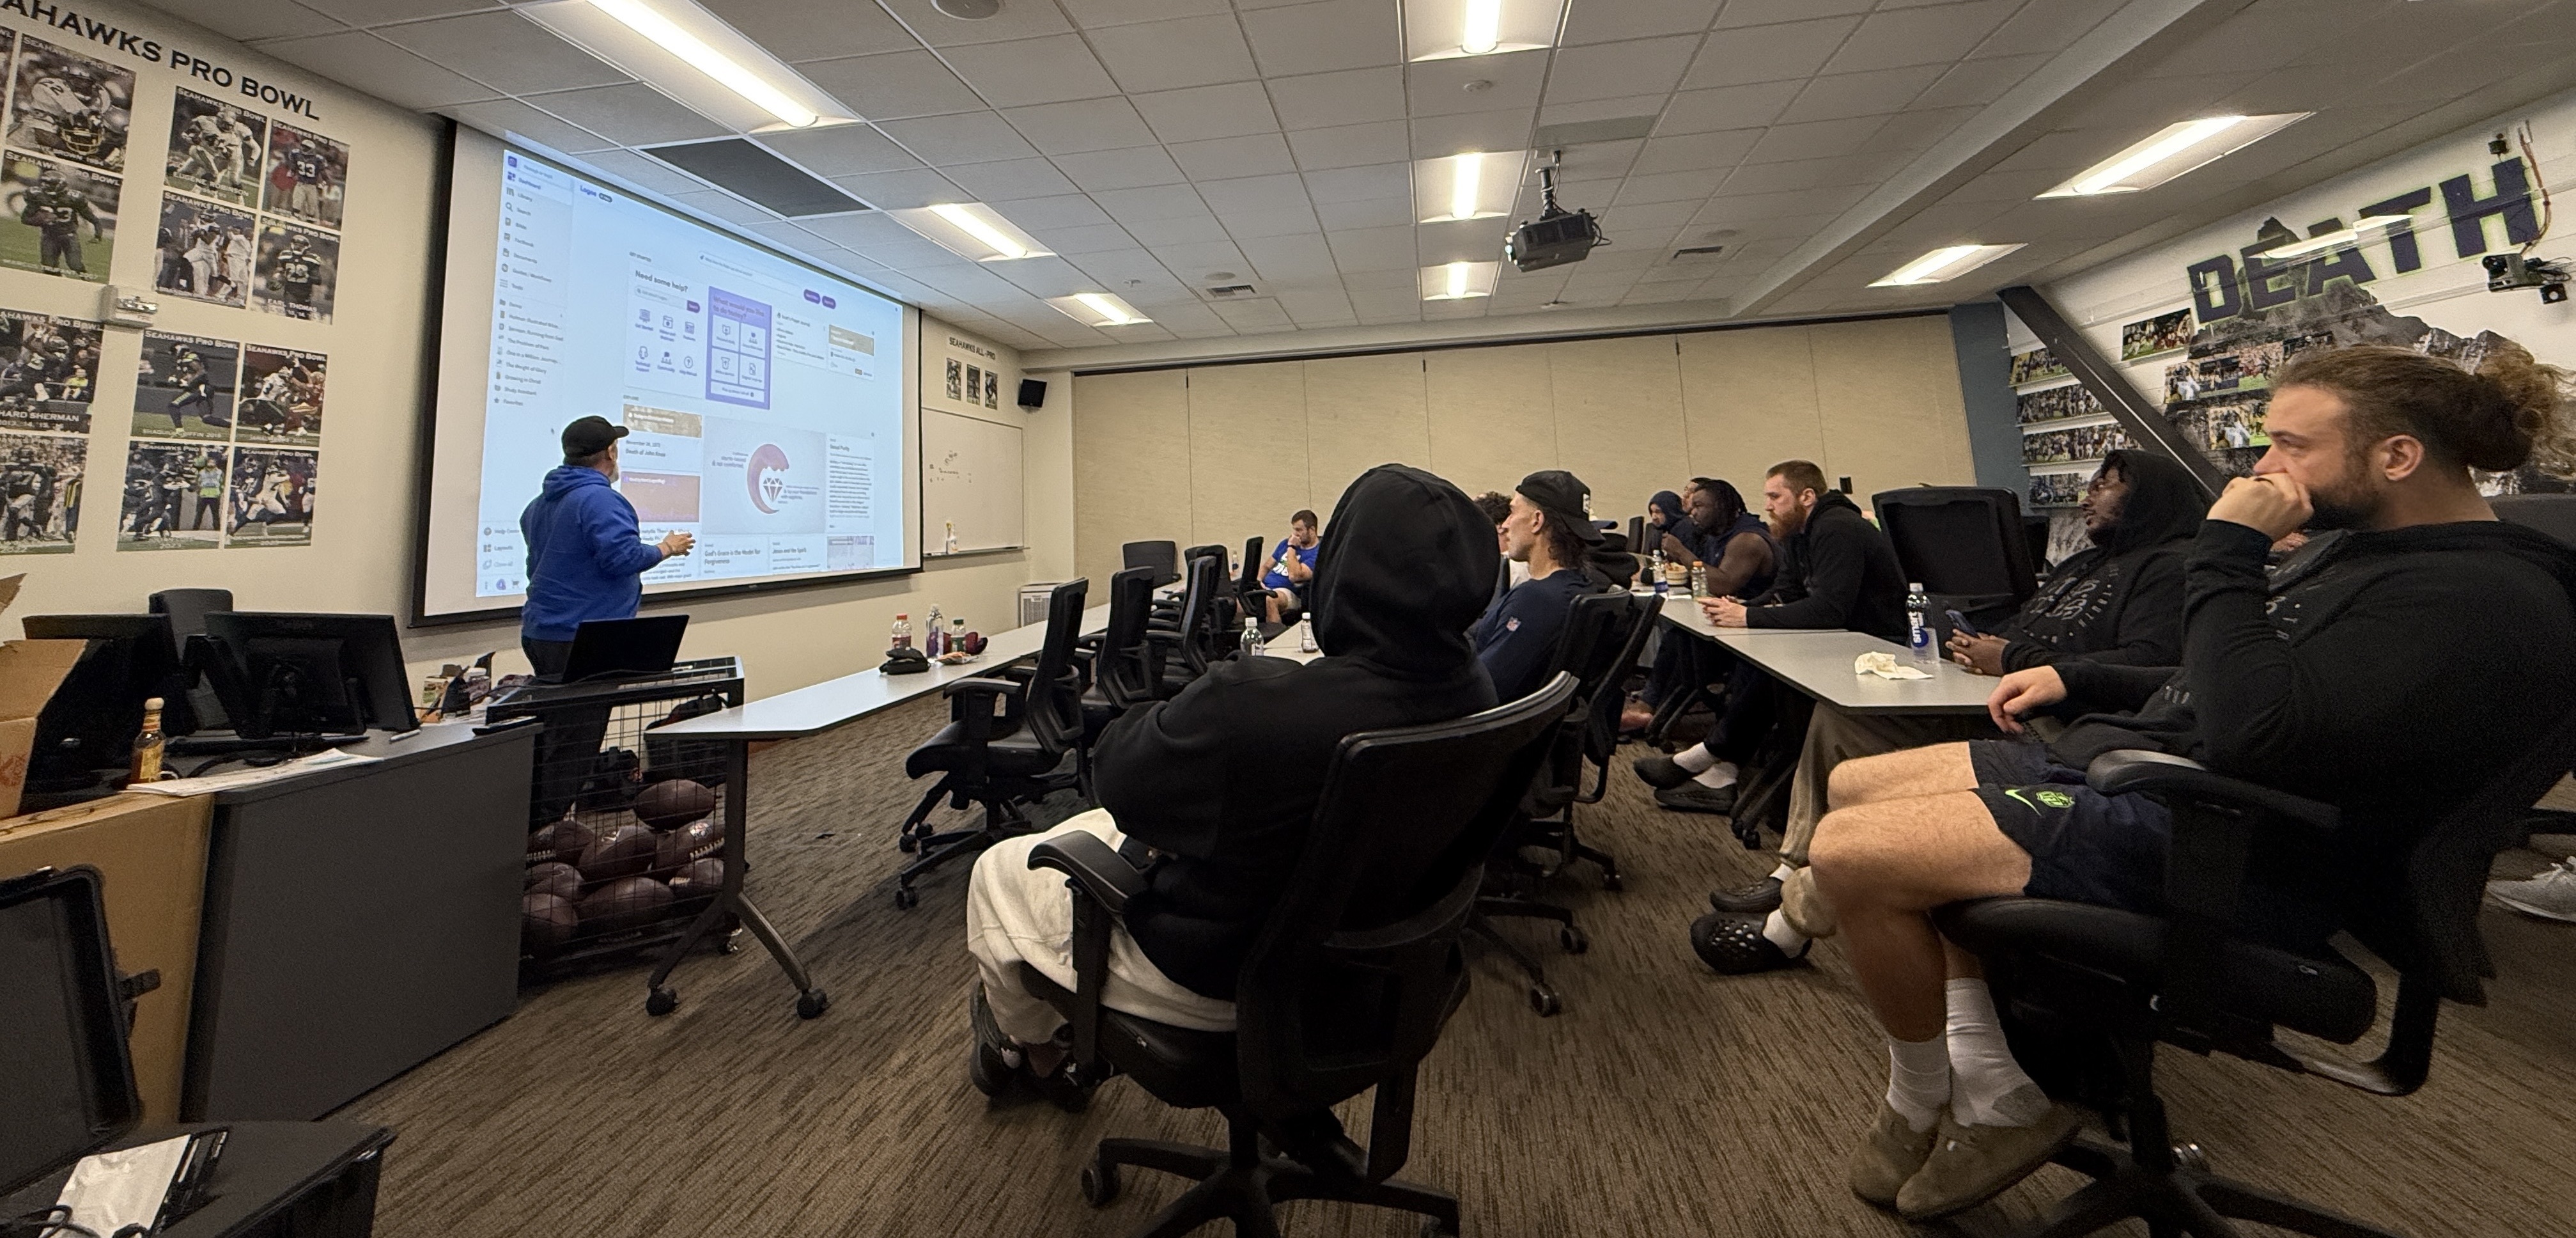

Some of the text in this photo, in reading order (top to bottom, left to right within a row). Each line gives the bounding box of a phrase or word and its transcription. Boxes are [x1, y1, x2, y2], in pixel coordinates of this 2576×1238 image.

[170, 49, 233, 88] PRO
[241, 77, 319, 120] BOWL
[177, 88, 266, 123] SEAHAWKS PRO BOWL
[273, 120, 311, 139] SEAHAWKS
[313, 133, 327, 144] PRO
[91, 171, 120, 186] BOWL
[297, 161, 315, 178] 33
[173, 171, 208, 187] EUGENE
[210, 182, 249, 197] ROBINSON
[164, 192, 212, 210] SEAHAWKS
[213, 205, 231, 215] PRO
[231, 209, 254, 220] BOWL
[262, 217, 339, 243] SEAHAWKS PRO BOWL
[2187, 156, 2540, 325] DEATH
[635, 269, 688, 293] Need some help?
[267, 298, 286, 308] EARL
[289, 302, 317, 313] THOMAS
[144, 331, 238, 350] SEAHAWKS PRO BOWL
[949, 336, 975, 352] SEAHAWKS
[246, 345, 327, 362] SEAHAWKS PRO BOWL
[29, 412, 79, 421] SHERMAN
[242, 448, 279, 457] SEAHAWKS
[1908, 611, 1921, 643] smart
